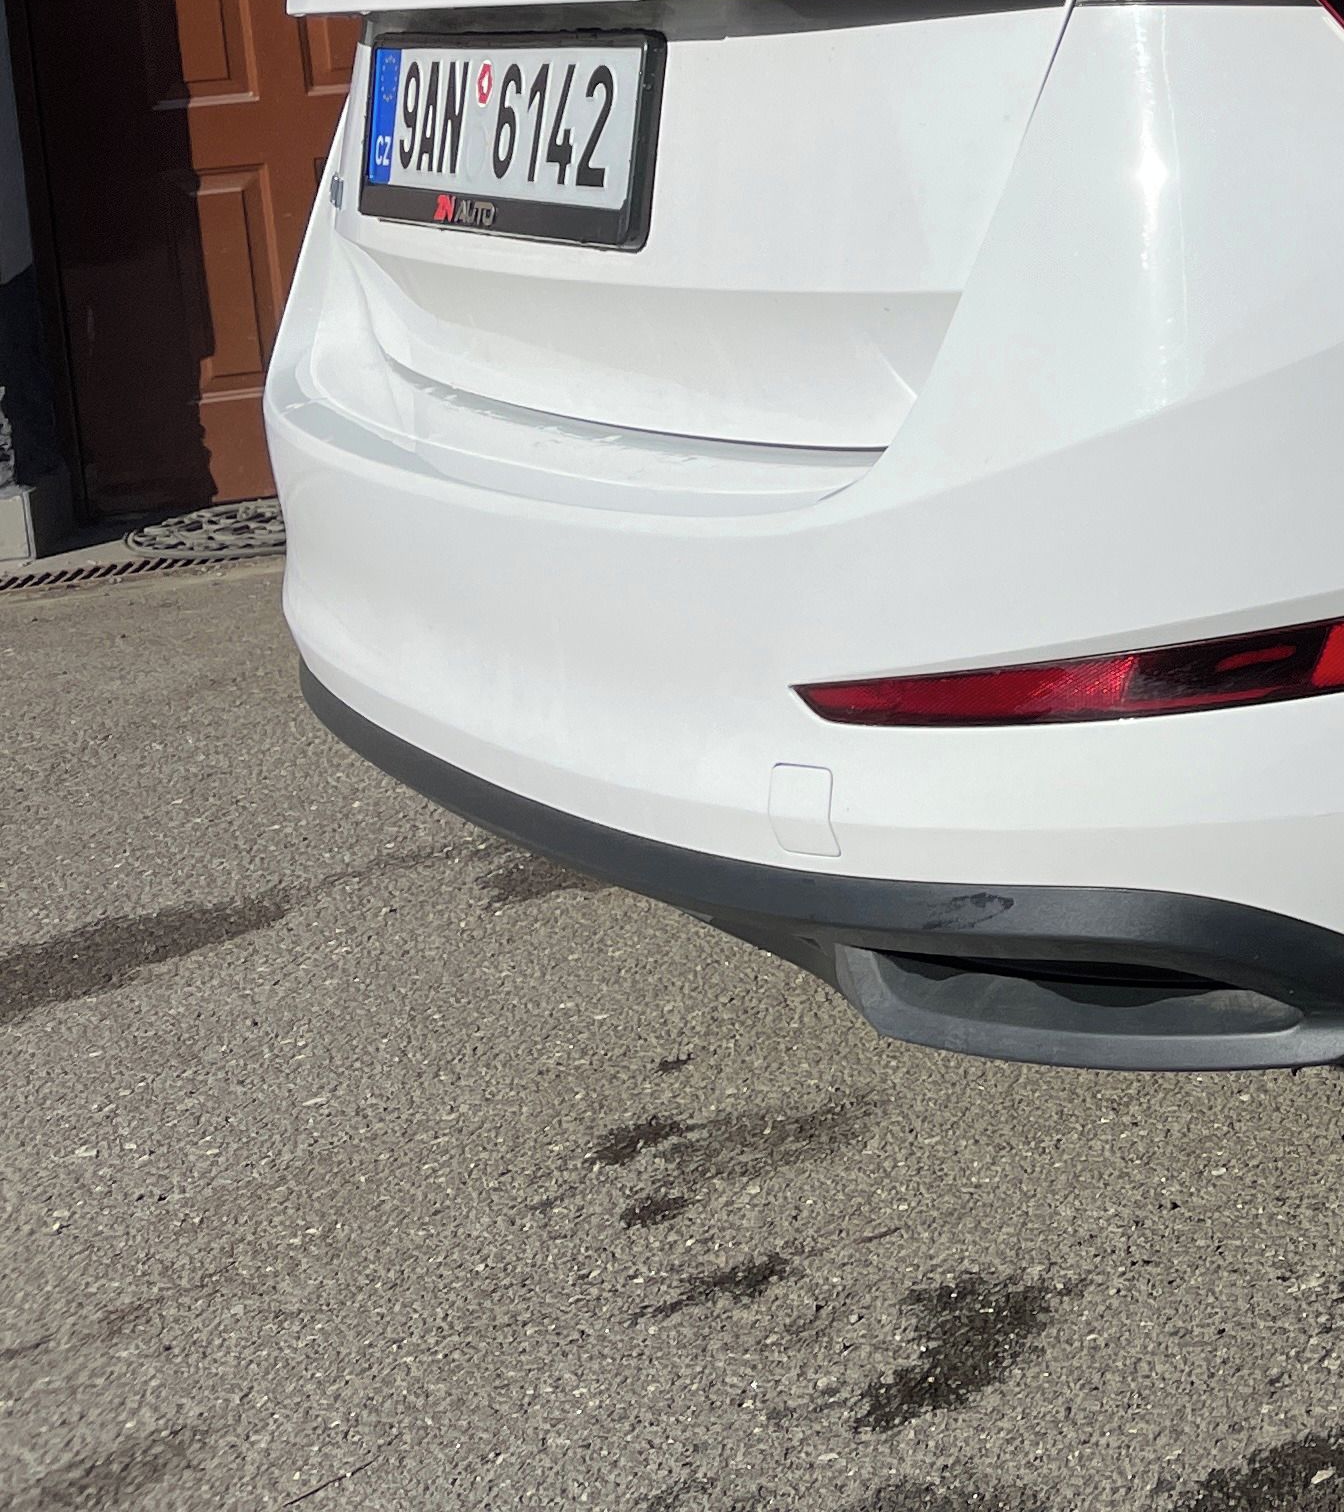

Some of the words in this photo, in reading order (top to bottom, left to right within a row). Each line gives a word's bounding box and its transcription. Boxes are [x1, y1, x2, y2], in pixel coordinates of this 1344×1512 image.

[399, 60, 470, 175] 9AN
[492, 63, 617, 189] 6142
[375, 134, 392, 167] CZ
[454, 199, 496, 226] AUTO
